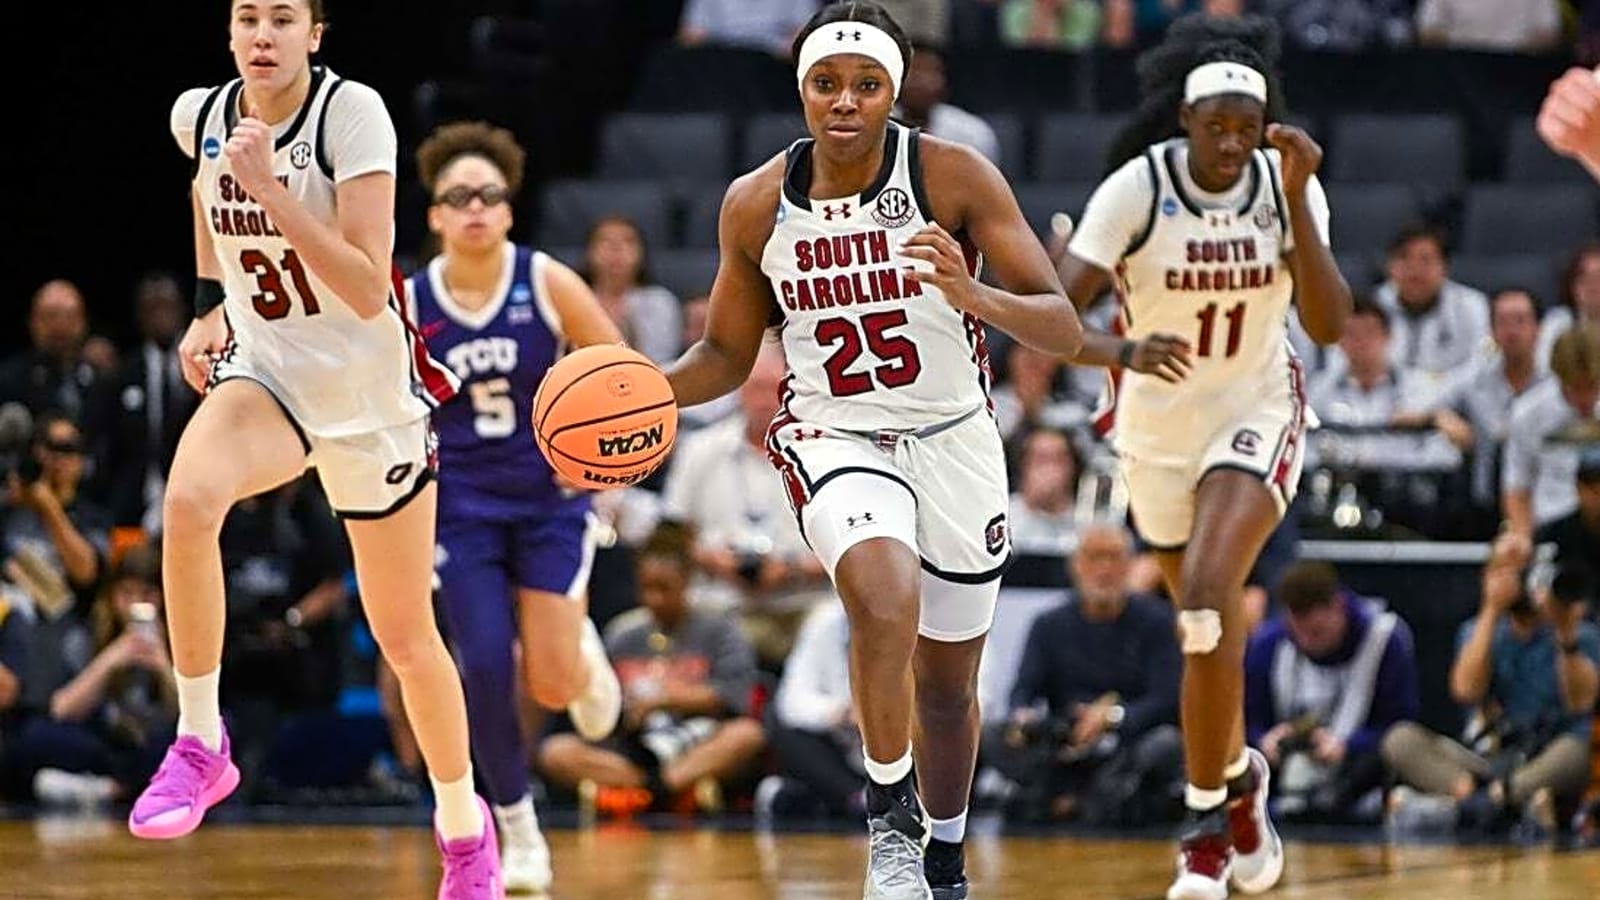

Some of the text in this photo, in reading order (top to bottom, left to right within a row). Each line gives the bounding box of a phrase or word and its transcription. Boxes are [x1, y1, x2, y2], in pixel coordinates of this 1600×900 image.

[211, 206, 283, 236] CAROL
[880, 190, 906, 217] SEC
[794, 230, 889, 272] SOUTH
[1186, 238, 1257, 263] SOUTH
[240, 249, 320, 321] 31
[781, 266, 923, 311] CAROLINA
[1165, 265, 1274, 290] CAROLINA
[1196, 302, 1246, 358] 11
[446, 337, 518, 380] TCU
[814, 309, 922, 397] 25
[469, 377, 516, 438] 5
[598, 423, 663, 456] NCAA
